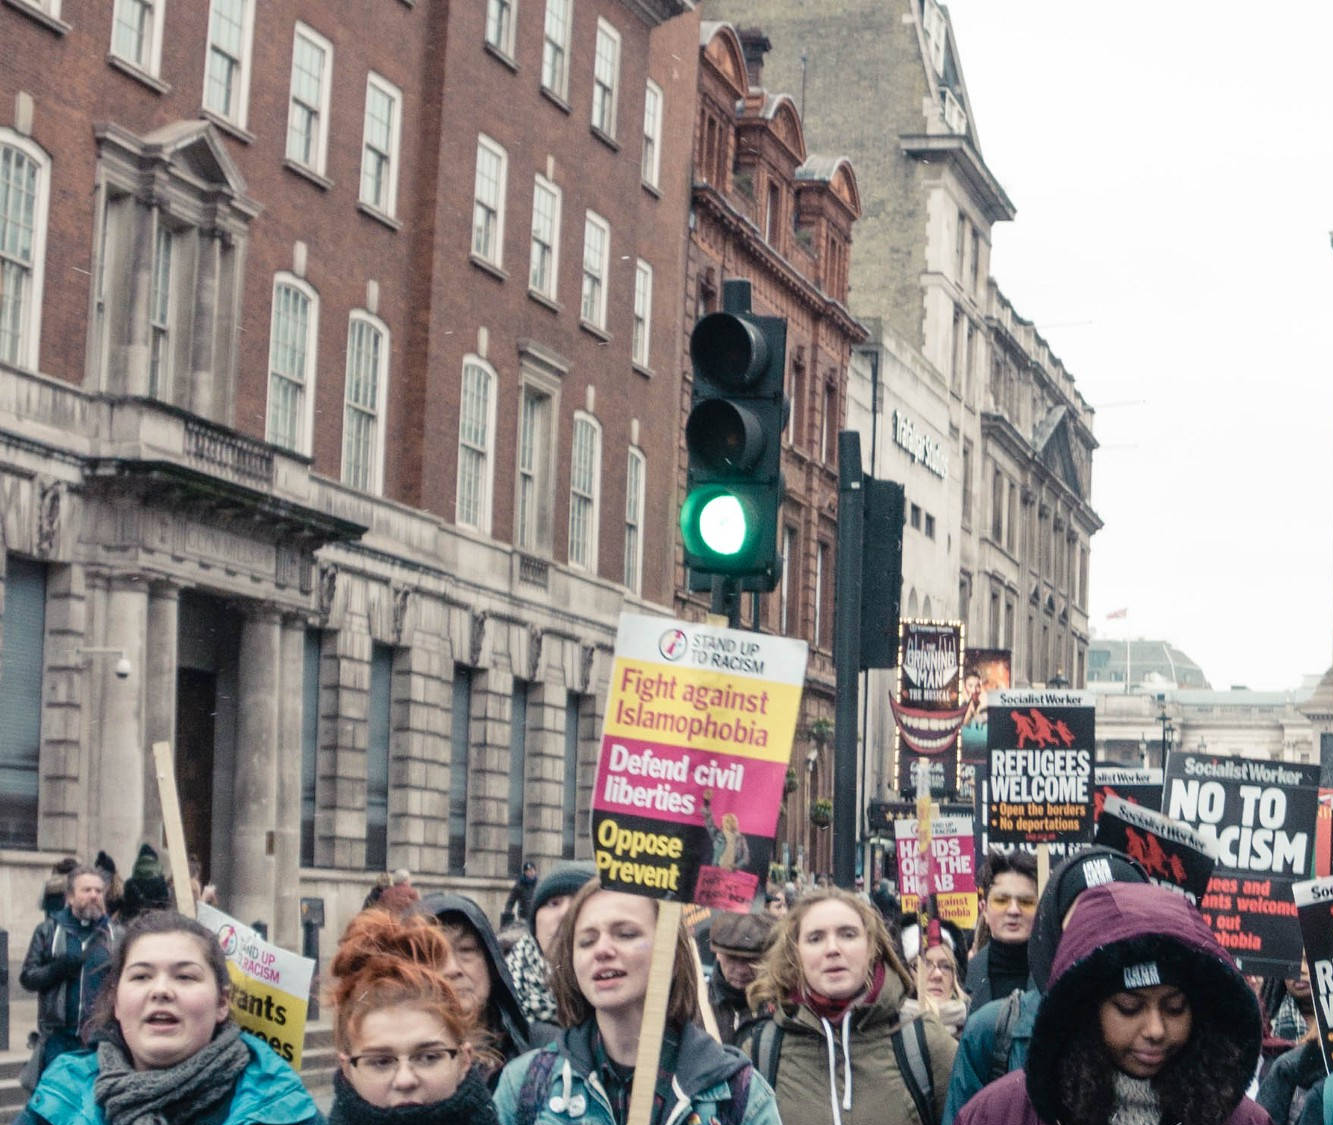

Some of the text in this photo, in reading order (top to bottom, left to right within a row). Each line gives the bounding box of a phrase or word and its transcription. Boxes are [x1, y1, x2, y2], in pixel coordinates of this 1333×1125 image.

[740, 641, 760, 657] UP
[710, 653, 766, 675] RACISM
[621, 667, 769, 716] Fight against
[917, 669, 944, 689] MAN
[616, 700, 768, 748] Islamophobia
[609, 744, 745, 792] Defend civil
[991, 749, 1091, 777] REFUGEES
[604, 775, 696, 815] liberties
[989, 775, 1089, 803] WELCOME
[1000, 803, 1086, 818] Open the borders
[1168, 778, 1287, 830] NO TO
[1000, 817, 1080, 832] No deportations
[598, 819, 683, 859] Oppose
[596, 851, 680, 891] Prevent
[936, 856, 972, 874] THE
[1242, 879, 1270, 896] and
[242, 960, 280, 985] RACISM
